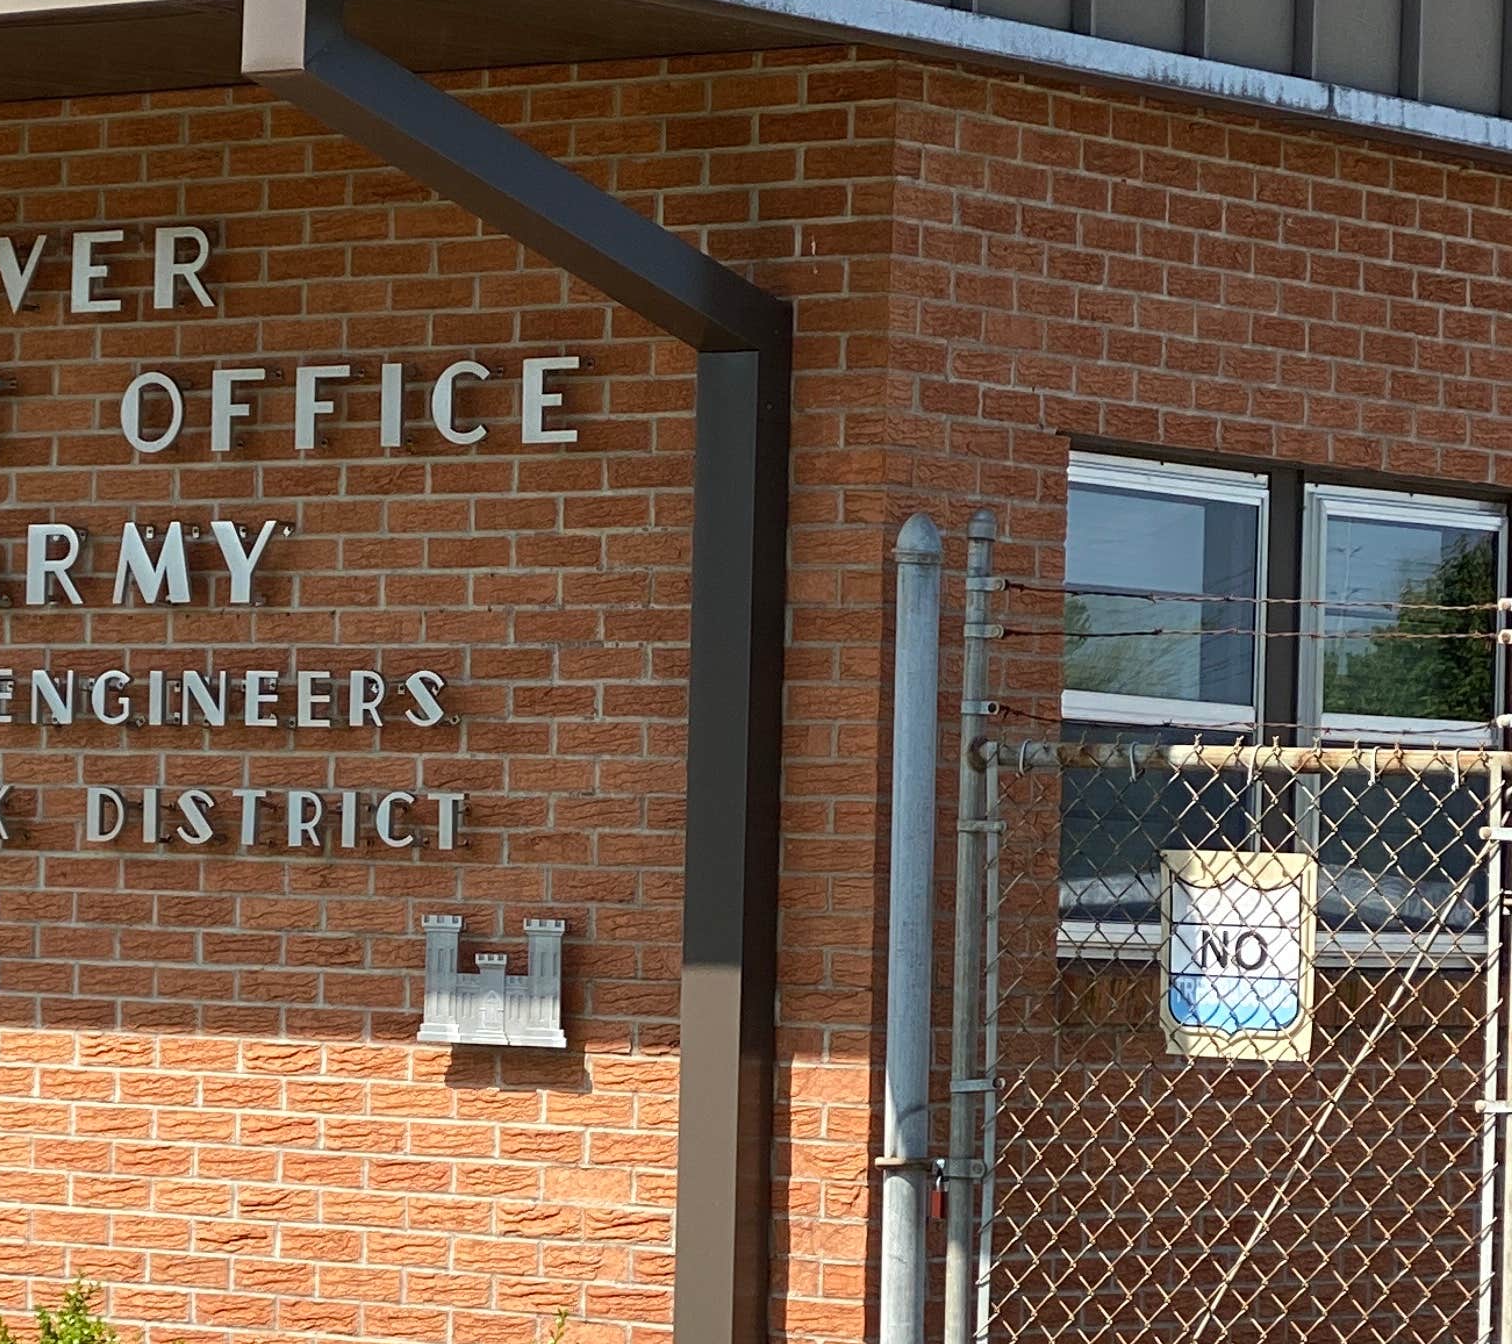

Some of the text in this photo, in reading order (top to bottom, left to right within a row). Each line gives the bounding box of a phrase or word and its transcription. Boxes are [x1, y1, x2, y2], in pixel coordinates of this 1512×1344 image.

[120, 356, 580, 453] OFFICE
[86, 784, 466, 850] DISTRICT
[1201, 930, 1268, 971] NO
